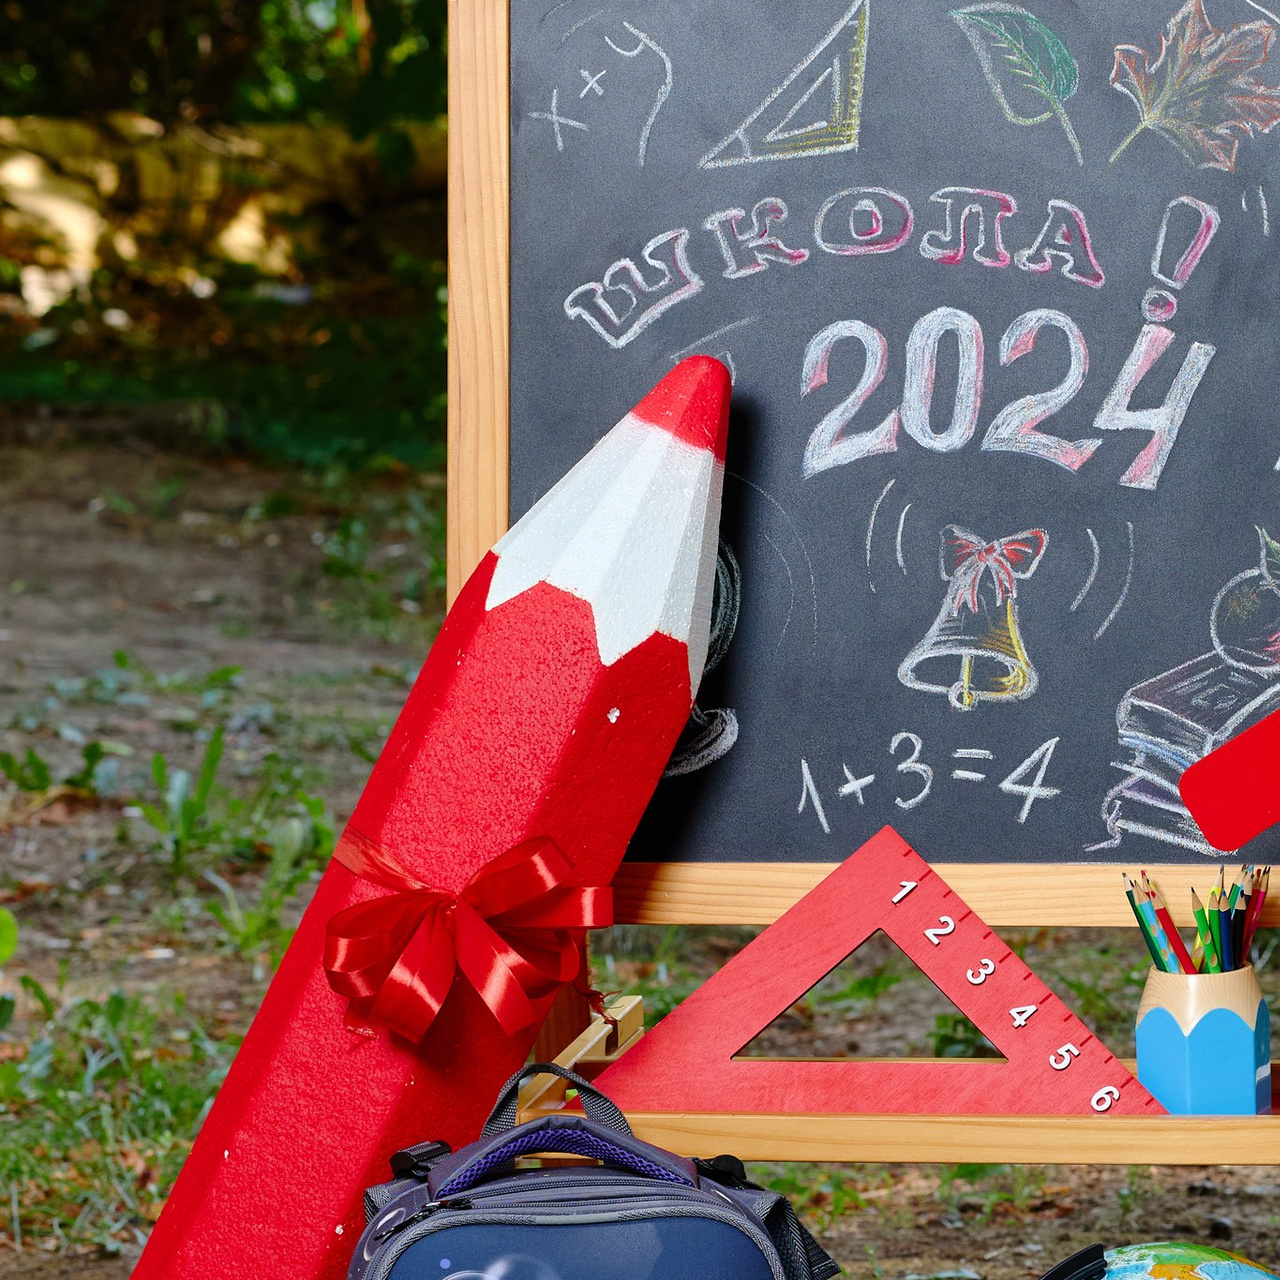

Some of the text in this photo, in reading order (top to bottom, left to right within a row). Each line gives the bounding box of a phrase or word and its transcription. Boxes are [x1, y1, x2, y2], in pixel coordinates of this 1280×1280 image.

[800, 305, 1217, 490] 2024
[890, 880, 1120, 1112] 1 2 3 4 5 6
